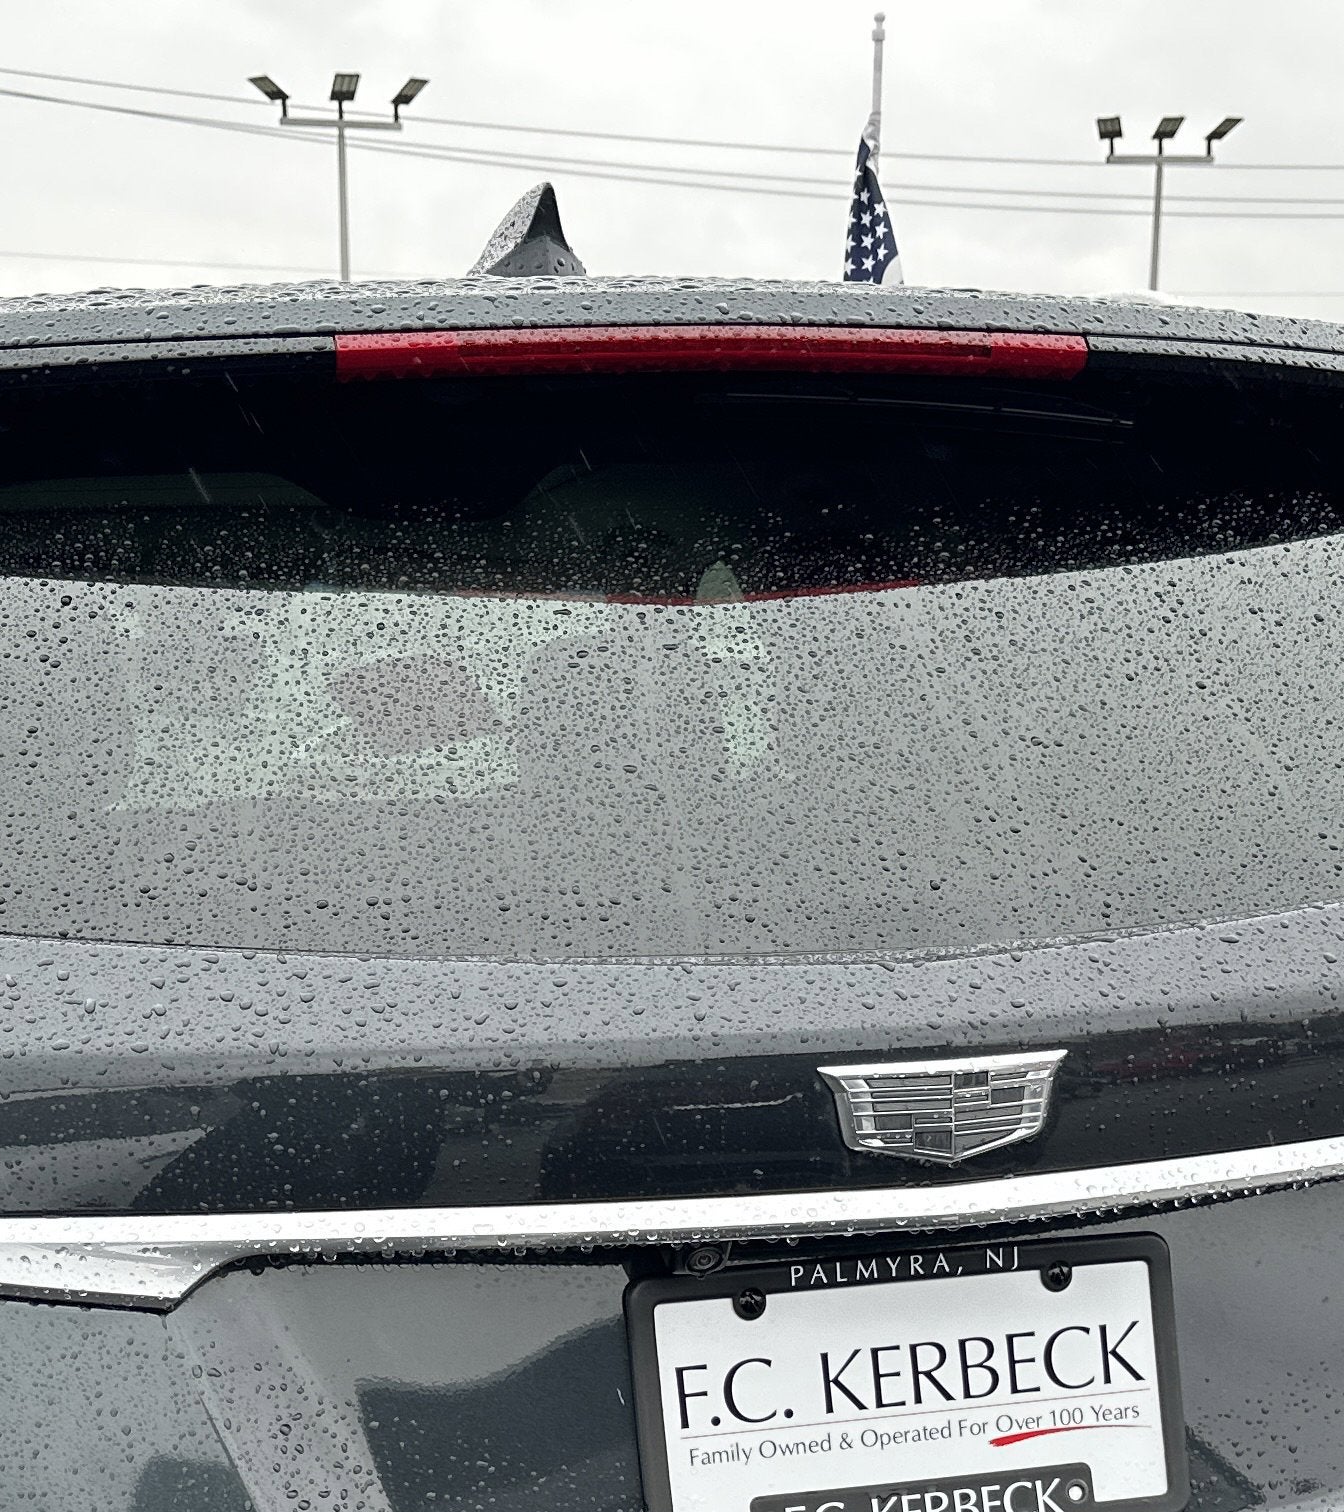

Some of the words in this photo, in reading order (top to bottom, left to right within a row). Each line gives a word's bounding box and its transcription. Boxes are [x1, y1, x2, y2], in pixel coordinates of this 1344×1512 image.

[790, 1252, 963, 1287] PALMYRA,
[986, 1246, 1019, 1271] NJ
[674, 1357, 794, 1430] F.C.
[819, 1320, 1146, 1414] KERBECK
[689, 1442, 753, 1467] Family
[759, 1432, 832, 1459] Owned
[839, 1432, 854, 1450] &
[860, 1419, 952, 1451] Operated
[958, 1419, 989, 1437] For
[995, 1413, 1043, 1433] Over
[1049, 1407, 1084, 1426] 100
[1090, 1404, 1140, 1423] Years
